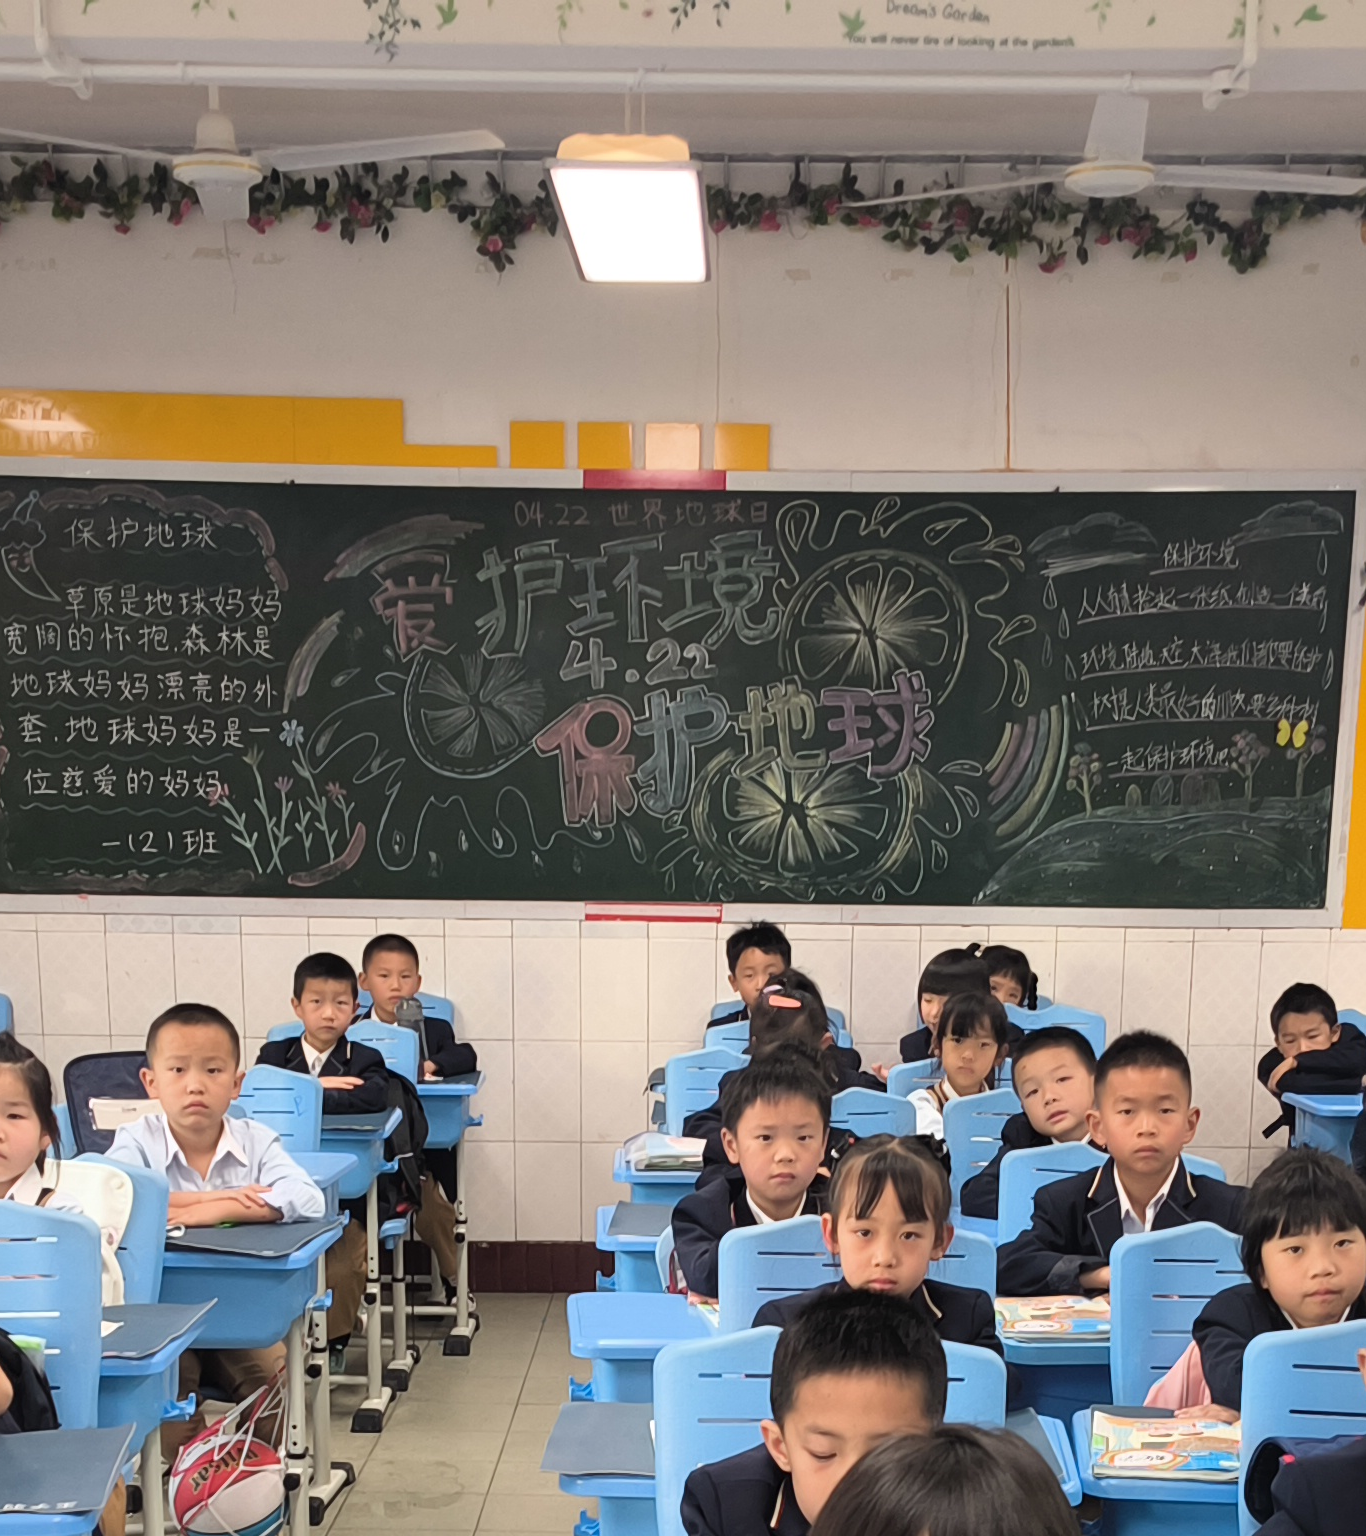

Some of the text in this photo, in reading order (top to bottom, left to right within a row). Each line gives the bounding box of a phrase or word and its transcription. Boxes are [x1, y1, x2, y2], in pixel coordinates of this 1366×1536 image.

[941, 3, 991, 24] Garden
[890, 36, 920, 45] never
[1012, 36, 1029, 47] the
[514, 498, 769, 527] 04.22 世界地球日
[63, 516, 218, 549] 保护地球
[1162, 536, 1241, 570] 保护环境
[64, 584, 283, 622] 草原是地球妈妈
[368, 530, 781, 662] 爱护环境
[559, 638, 719, 689] 4.22
[10, 669, 279, 708] 地球妈妈漂亮的外
[534, 668, 935, 828] 保护地球
